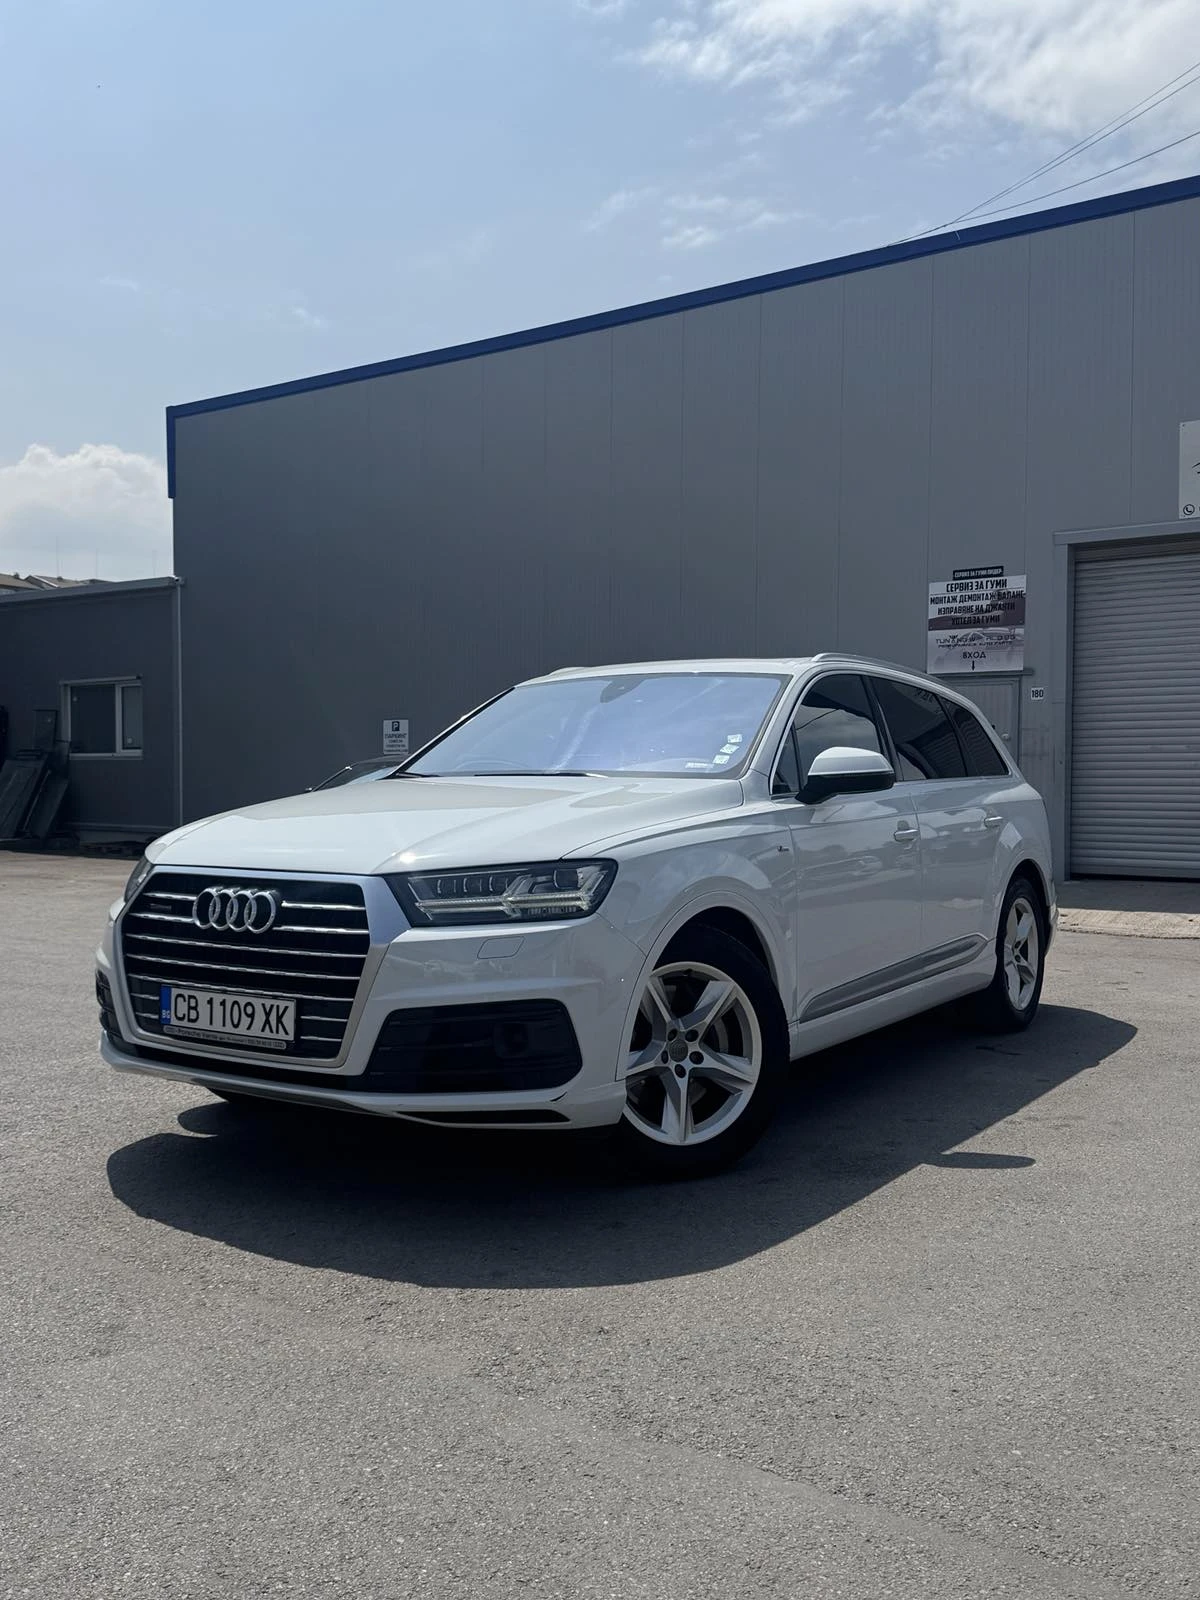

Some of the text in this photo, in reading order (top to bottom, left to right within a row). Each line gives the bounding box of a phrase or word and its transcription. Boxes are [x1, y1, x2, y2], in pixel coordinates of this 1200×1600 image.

[946, 579, 1008, 593] СЕРВИЗ ЗА ГУМИ
[930, 595, 958, 605] МОНТАЖ
[959, 592, 996, 604] ДЕМОНТАЖ
[937, 605, 974, 615] ИЗПРАВЯНЕ
[975, 604, 984, 613] НА
[972, 615, 981, 625] ЗА
[962, 651, 986, 659] ВХОД
[1032, 689, 1044, 698] 180
[174, 993, 289, 1036] CB 1109 XK
